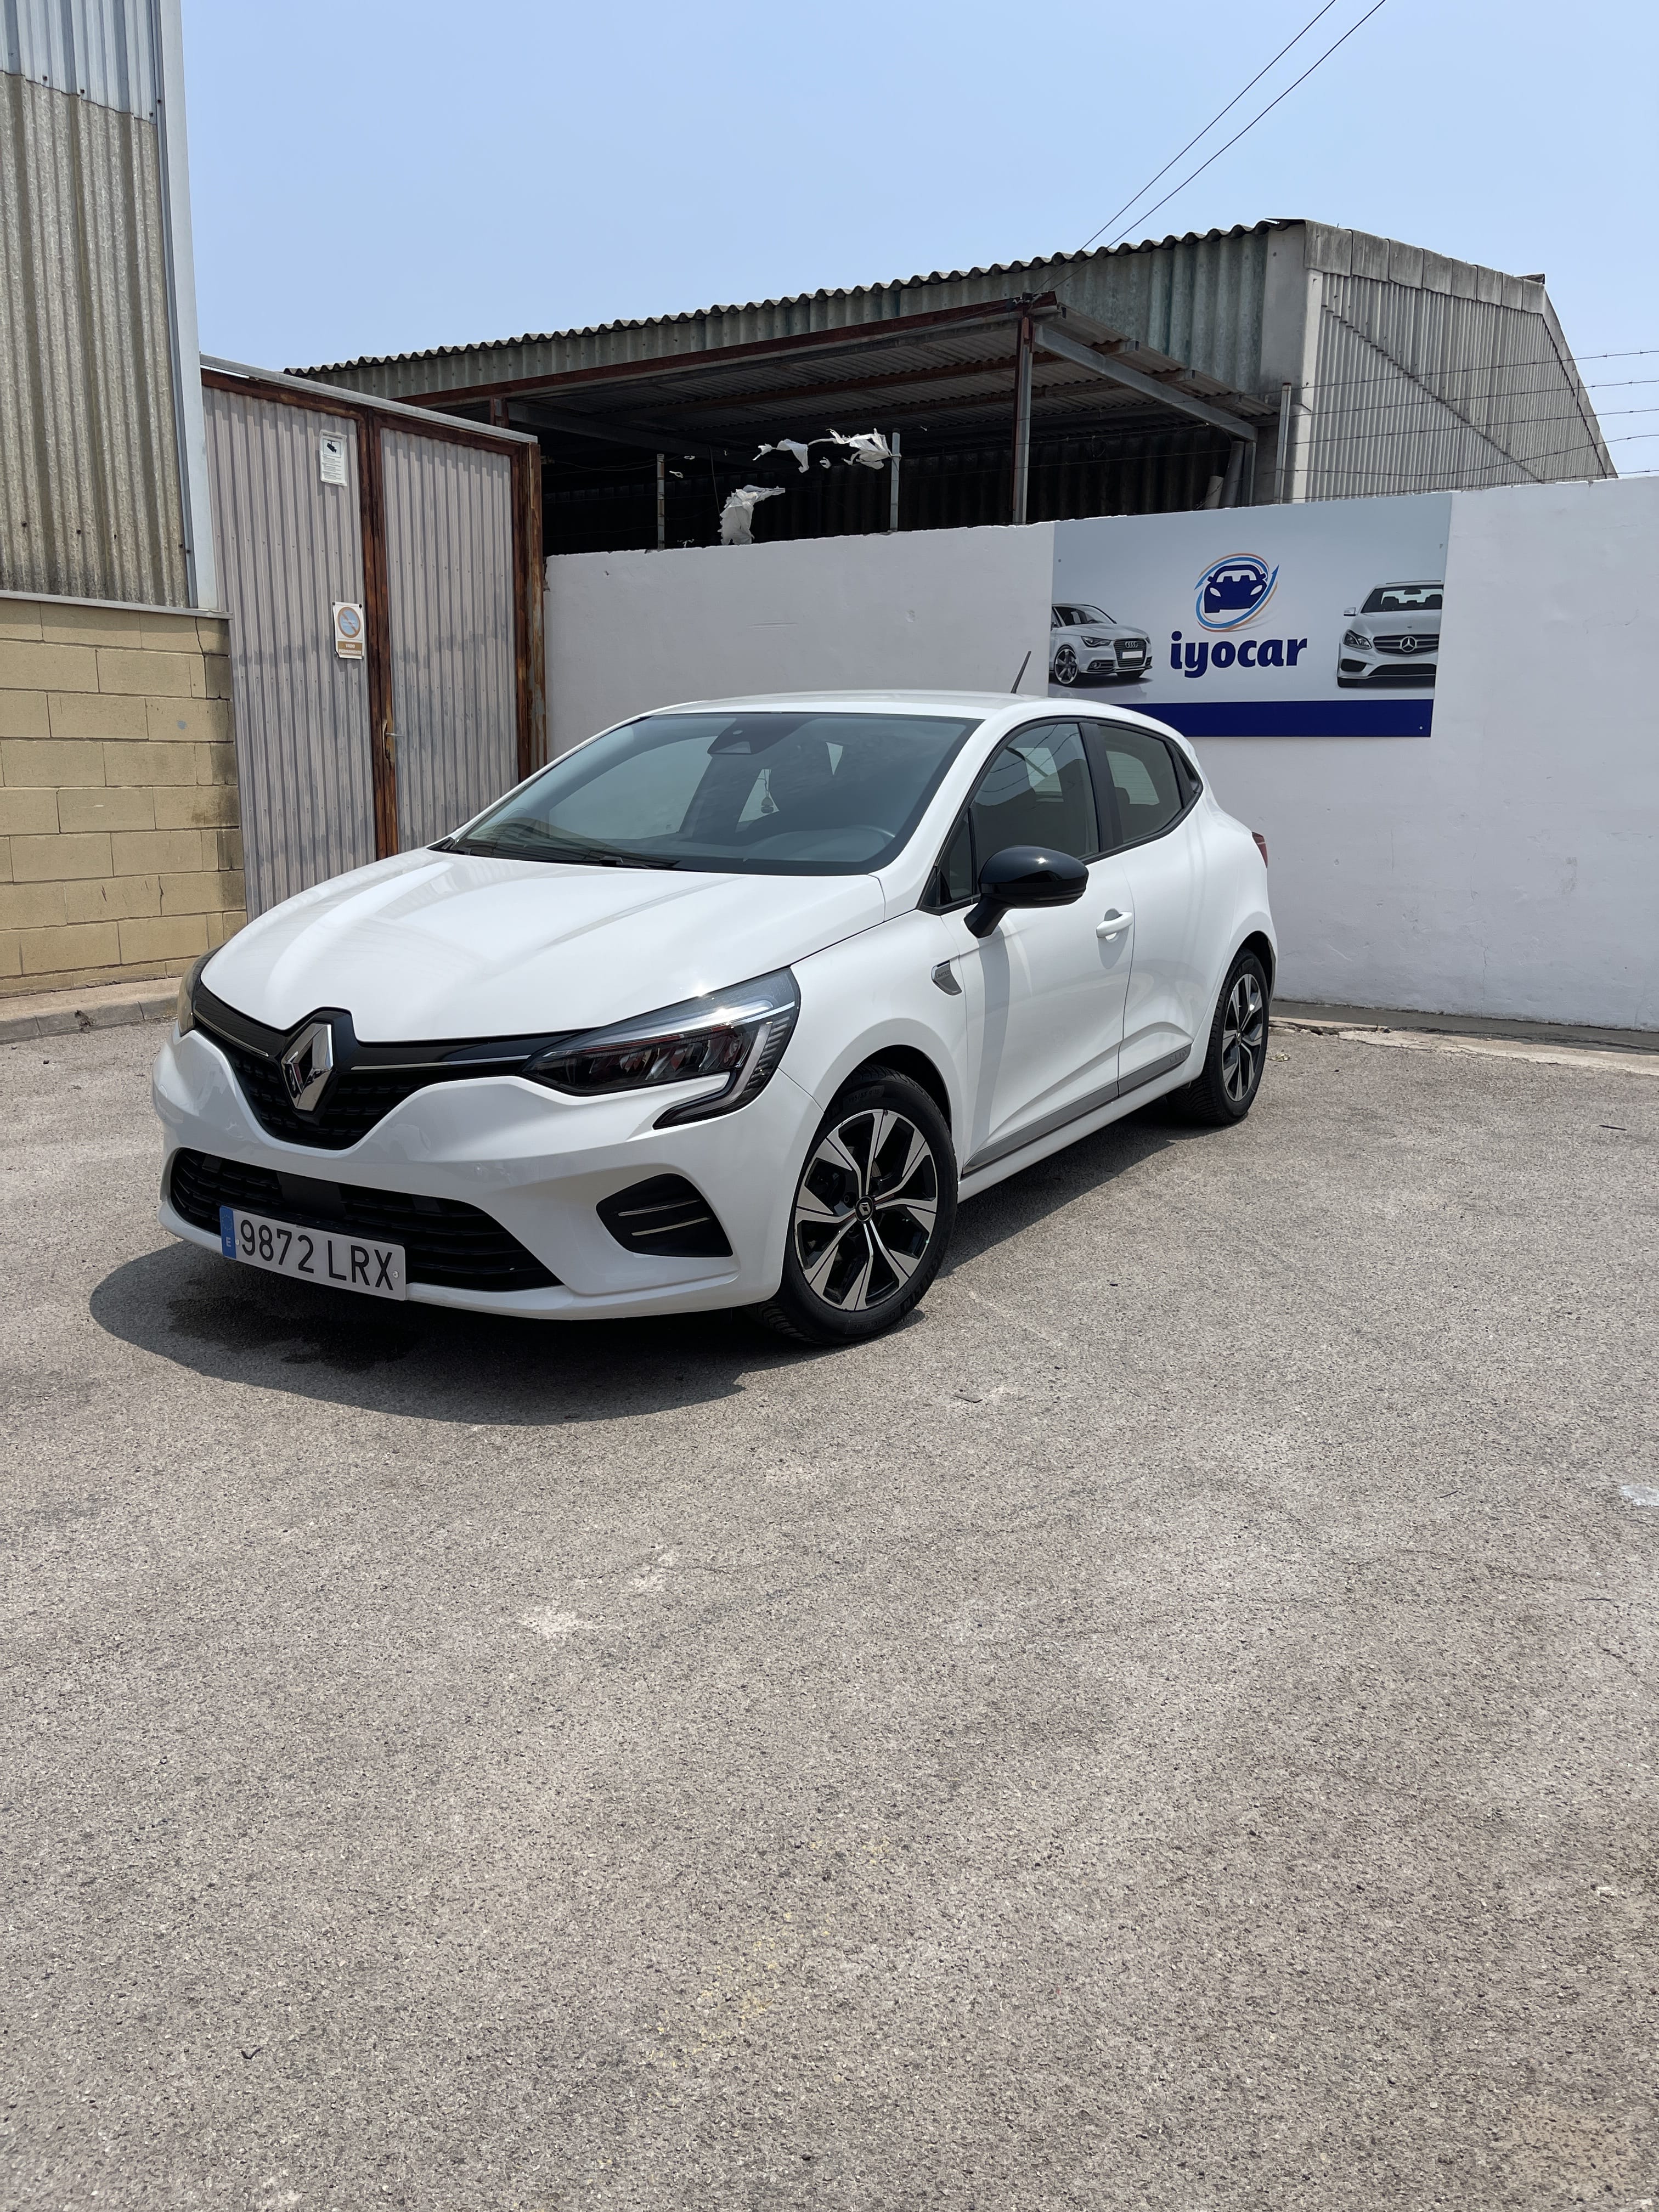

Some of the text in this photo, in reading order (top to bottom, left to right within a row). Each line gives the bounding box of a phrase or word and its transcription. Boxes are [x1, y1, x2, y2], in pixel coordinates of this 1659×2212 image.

[1170, 631, 1307, 678] iyocar
[225, 1237, 232, 1248] E
[240, 1219, 393, 1291] 9872 LRX
